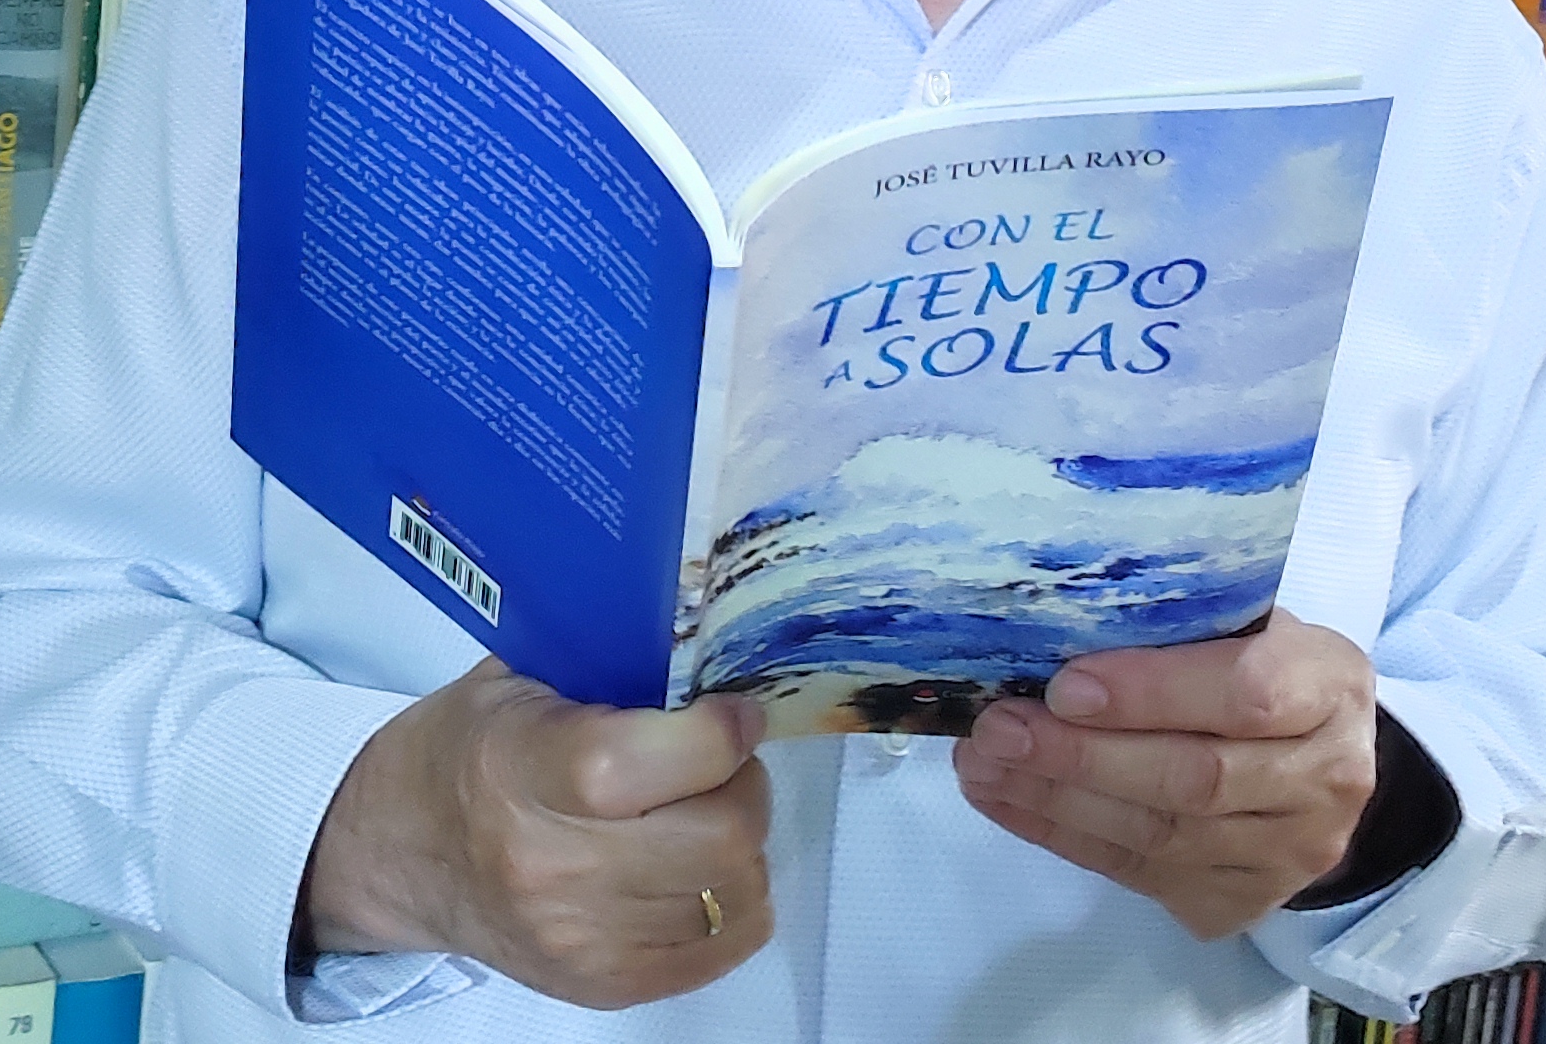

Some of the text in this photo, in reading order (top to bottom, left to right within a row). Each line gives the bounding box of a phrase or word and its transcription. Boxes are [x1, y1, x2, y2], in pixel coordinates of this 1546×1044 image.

[874, 148, 1166, 199] JOSÉ TUVILLA RAYO
[905, 208, 1115, 256] CON EL
[812, 257, 1208, 348] TIEMPO
[823, 320, 1181, 390] A SOLAS
